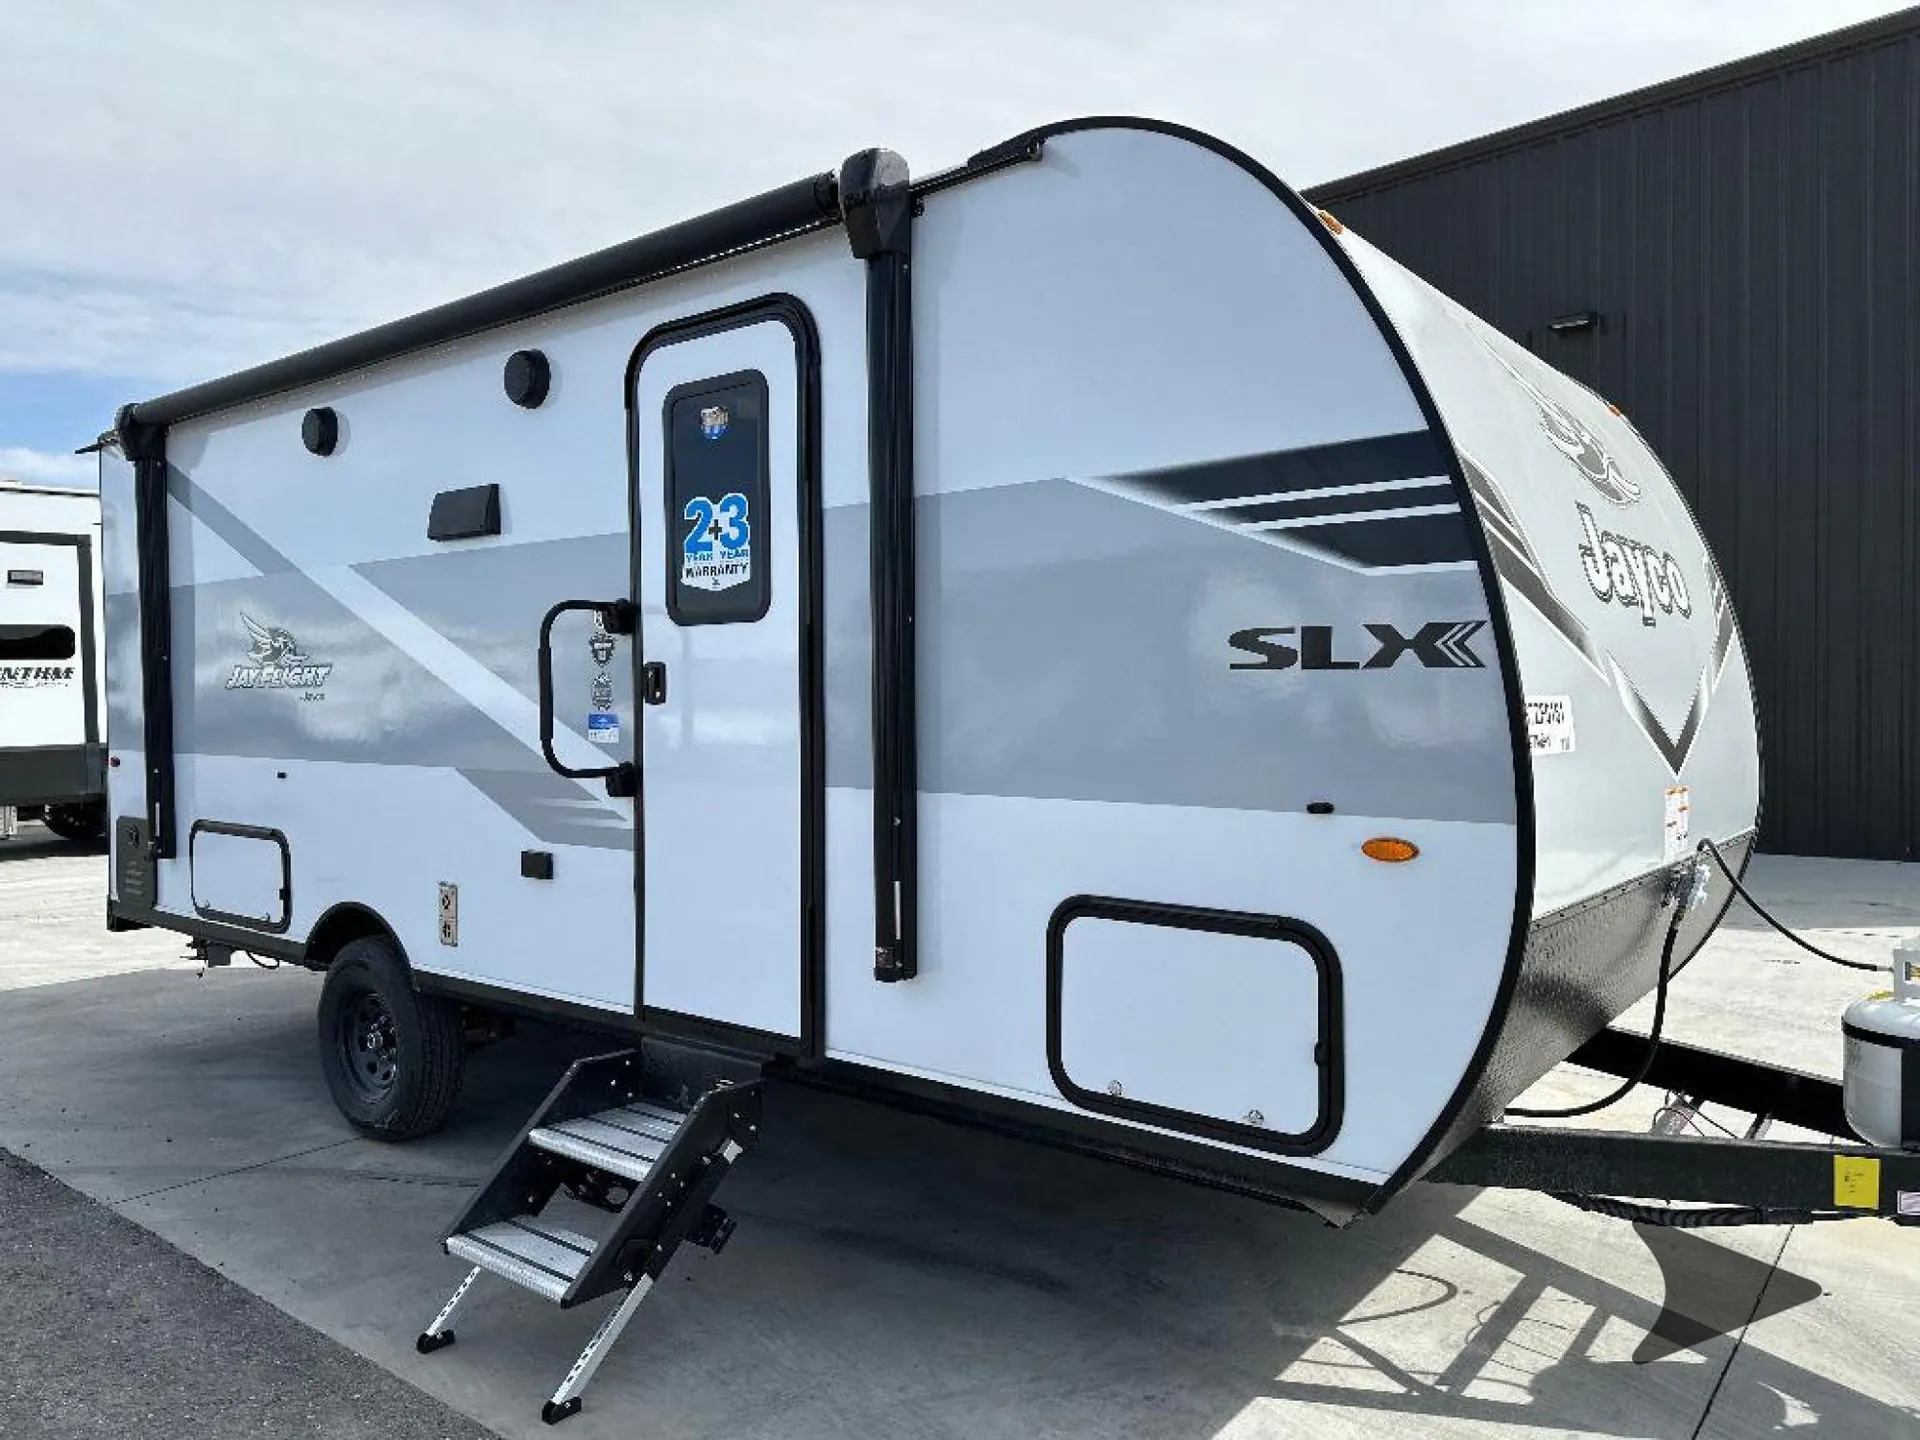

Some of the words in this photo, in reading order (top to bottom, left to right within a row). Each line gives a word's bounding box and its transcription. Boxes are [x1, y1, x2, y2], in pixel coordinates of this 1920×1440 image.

[685, 561, 749, 579] WARRANTY
[720, 548, 749, 560] YEAR
[1576, 500, 1691, 626] Jayco
[1228, 621, 1487, 670] SLX
